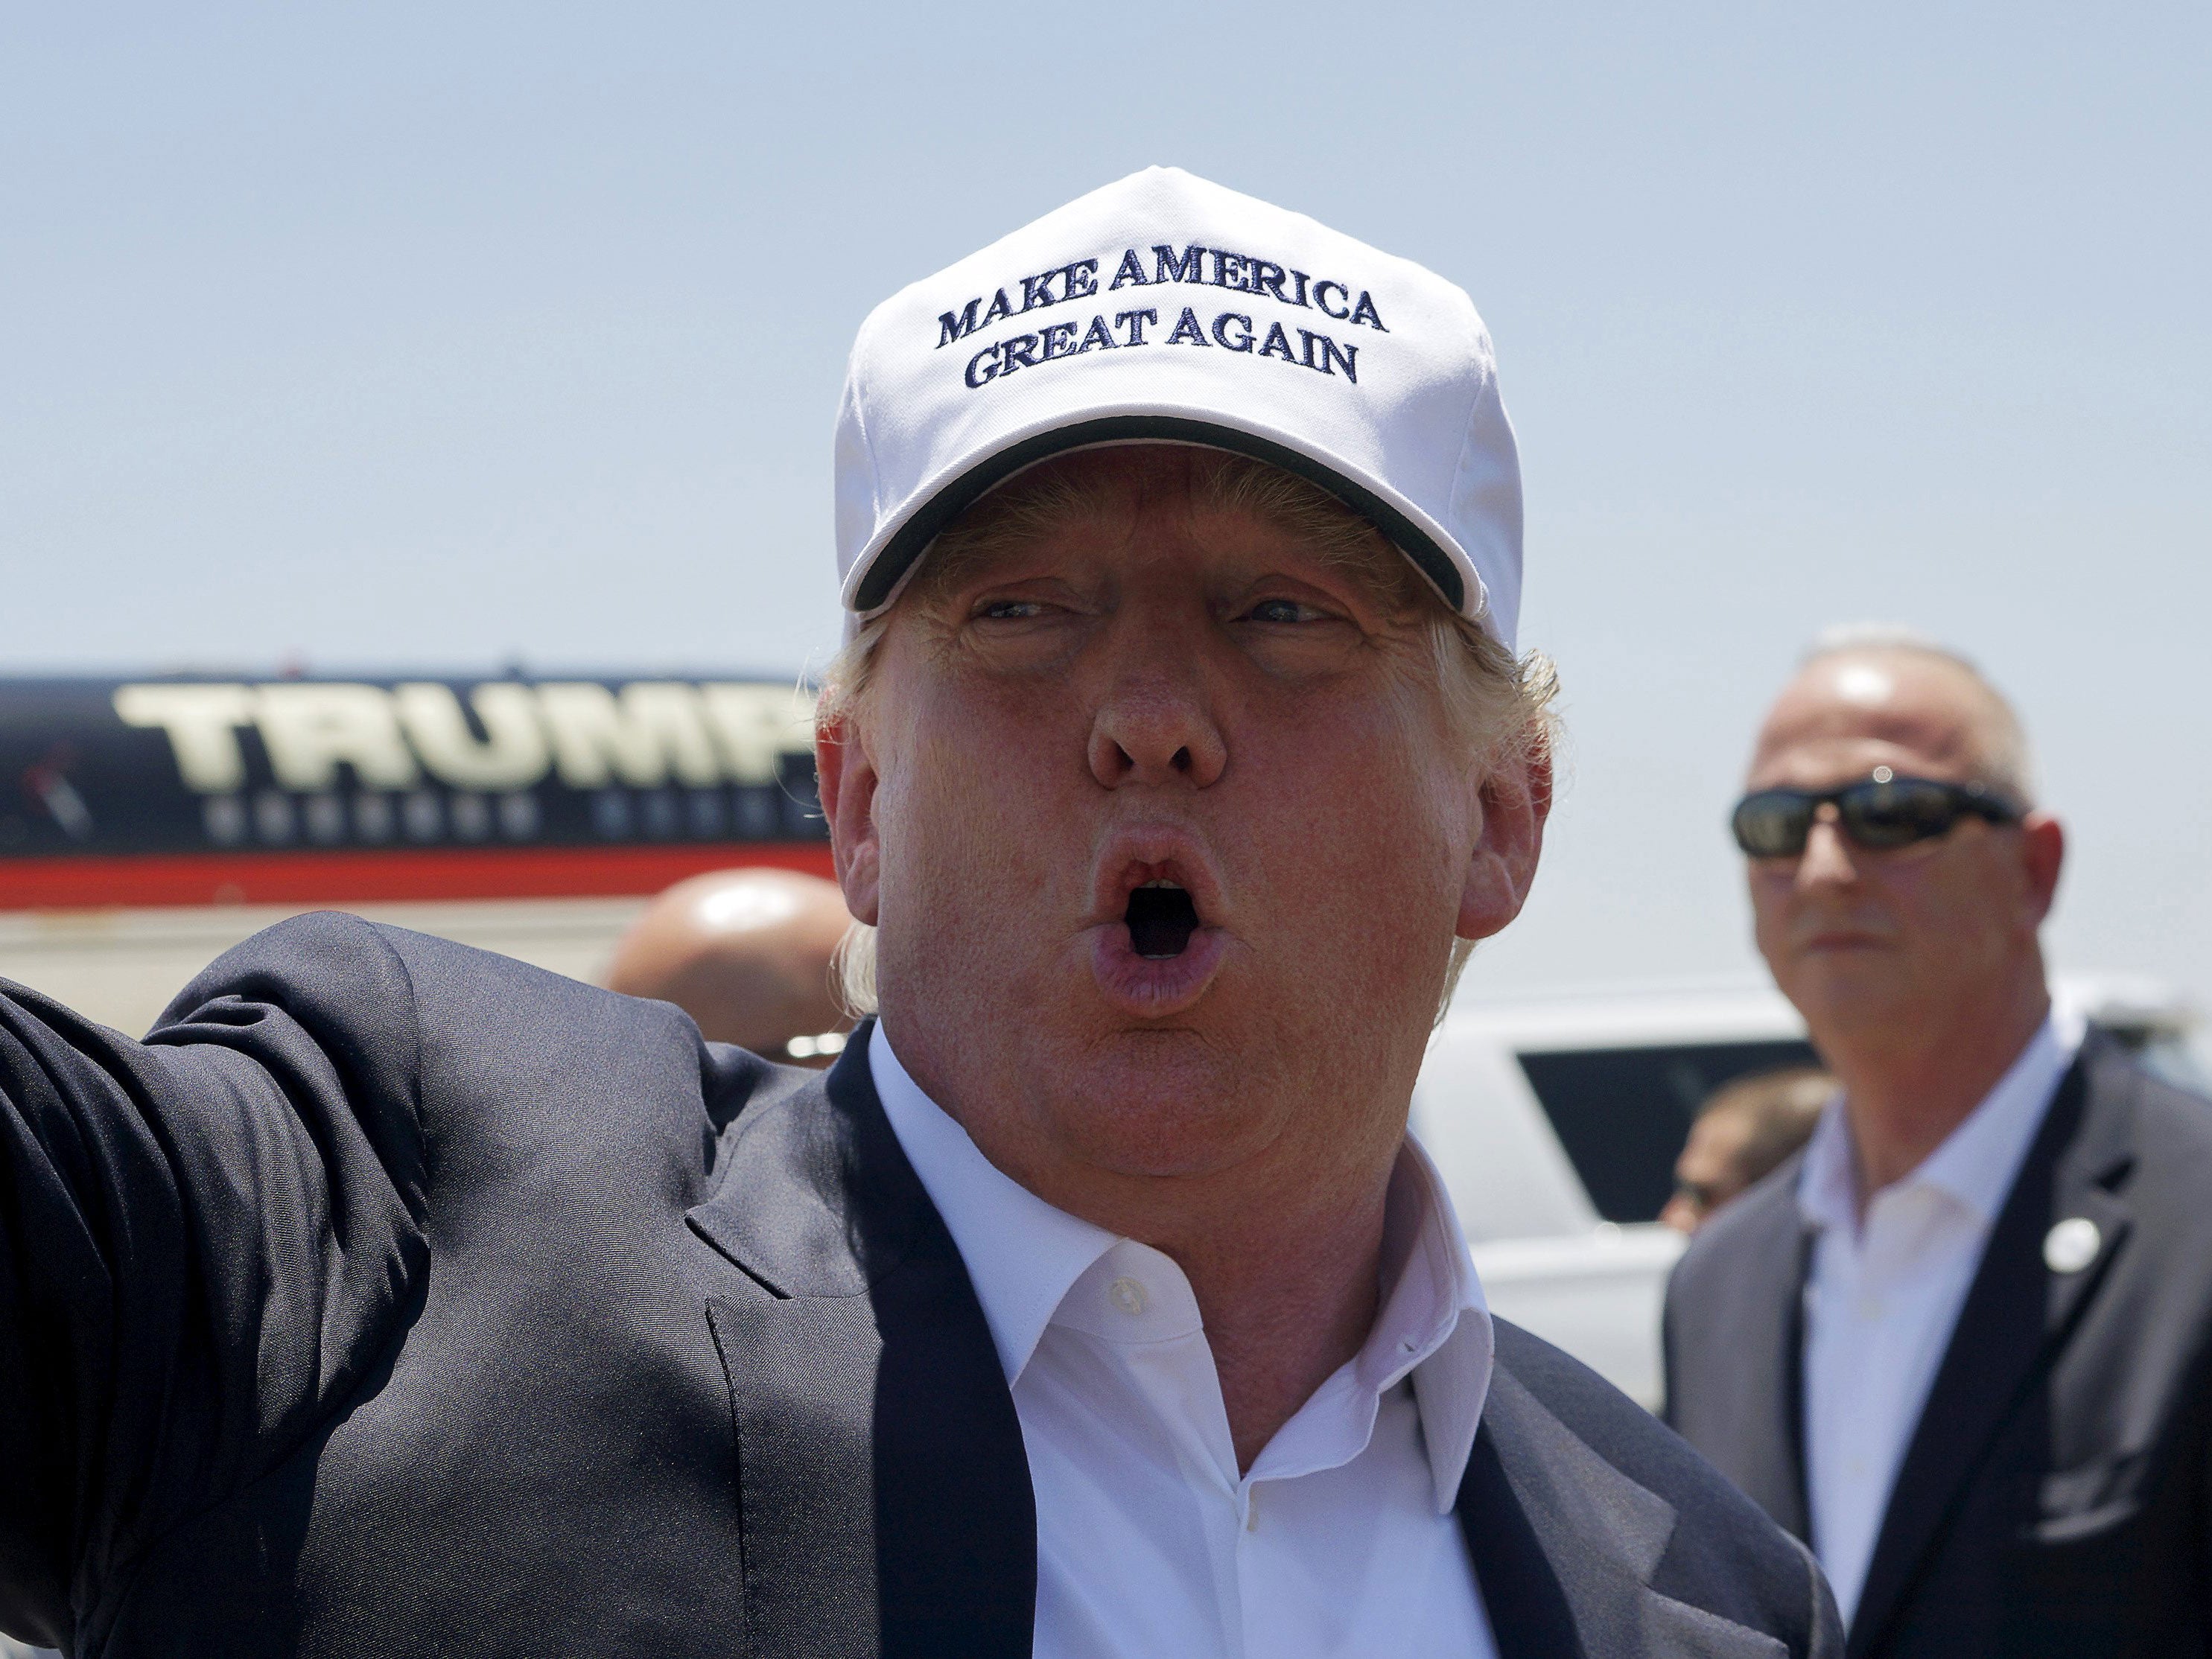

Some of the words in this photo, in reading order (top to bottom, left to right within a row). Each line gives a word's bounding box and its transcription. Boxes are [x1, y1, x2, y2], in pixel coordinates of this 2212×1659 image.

[936, 258, 1099, 349] MAKE
[1109, 244, 1391, 332] AMERICA
[964, 308, 1158, 389] GREAT
[1165, 307, 1358, 384] AGAIN
[113, 683, 817, 789] TRUMP
